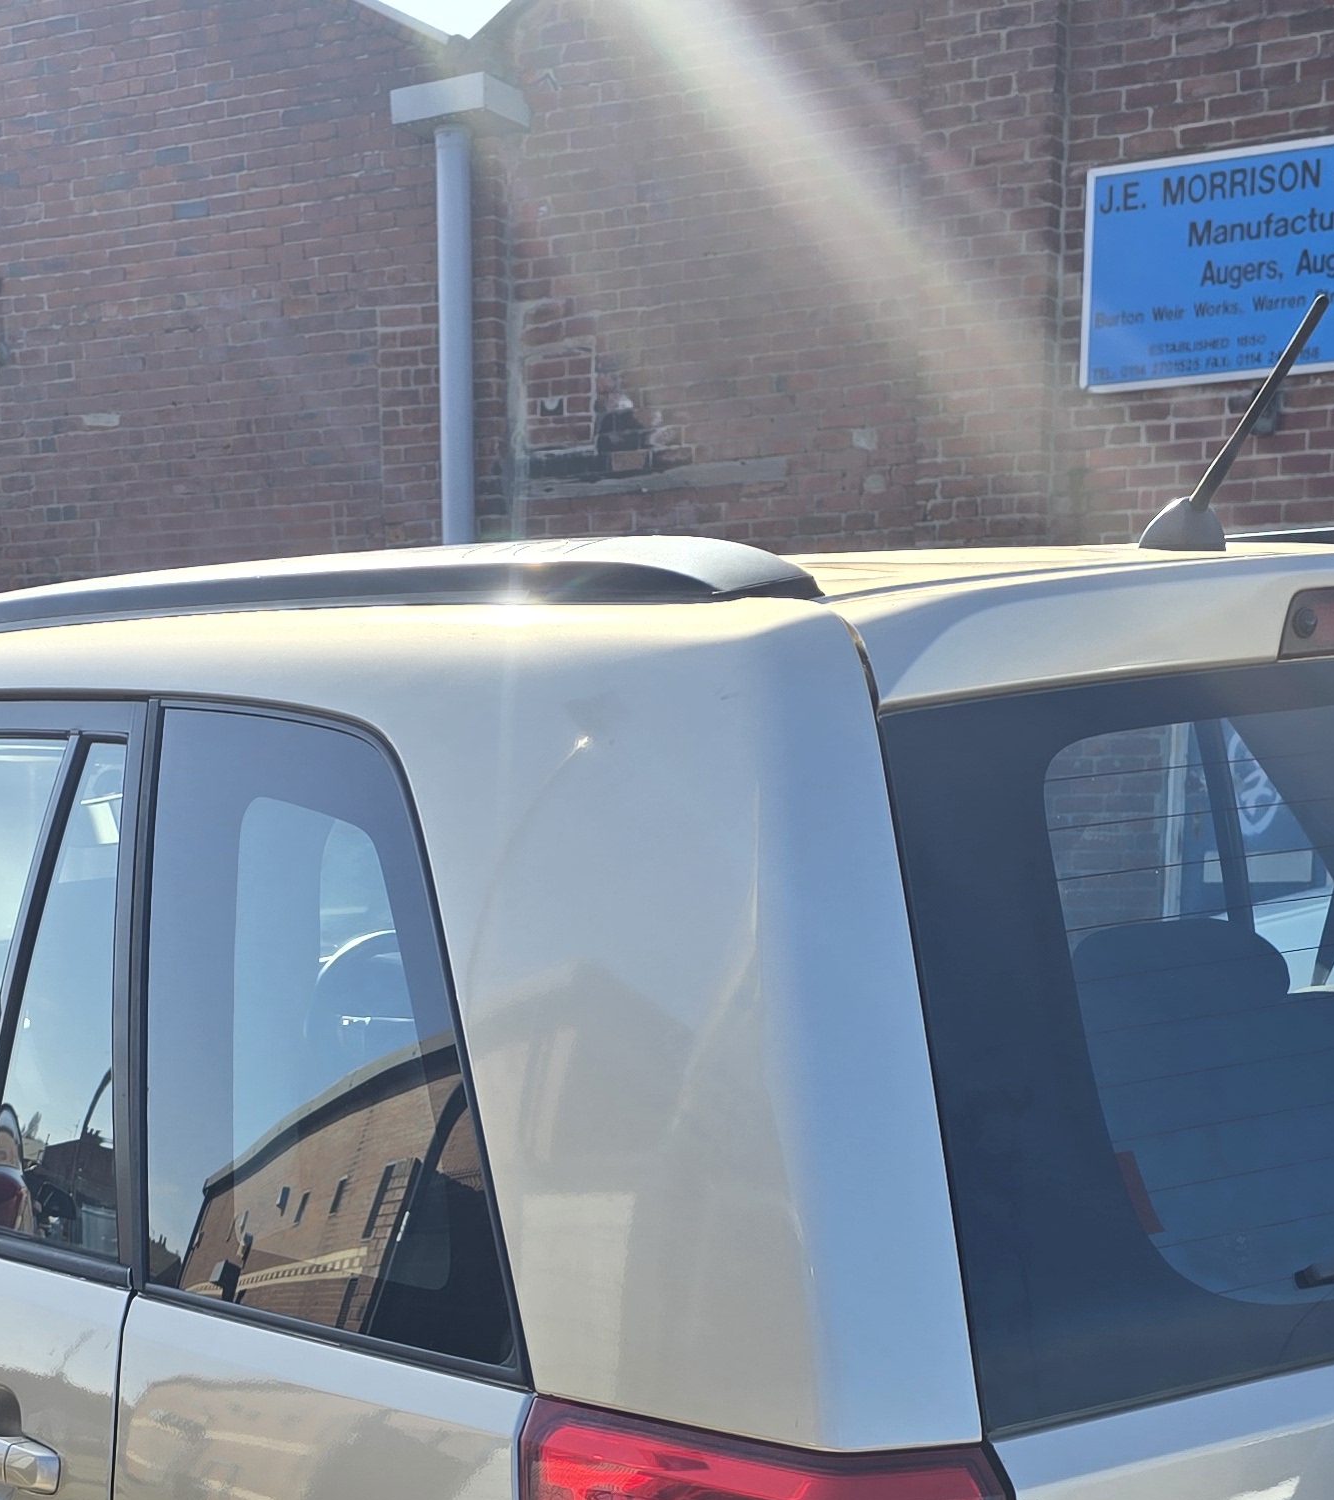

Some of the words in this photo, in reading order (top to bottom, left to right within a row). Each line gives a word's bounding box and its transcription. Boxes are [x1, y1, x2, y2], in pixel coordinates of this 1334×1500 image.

[1098, 180, 1148, 215] J.E.
[1162, 157, 1322, 208] MORRISON
[1200, 256, 1284, 290] Augers,
[1152, 305, 1187, 323] Weir
[1252, 294, 1307, 313] Warren
